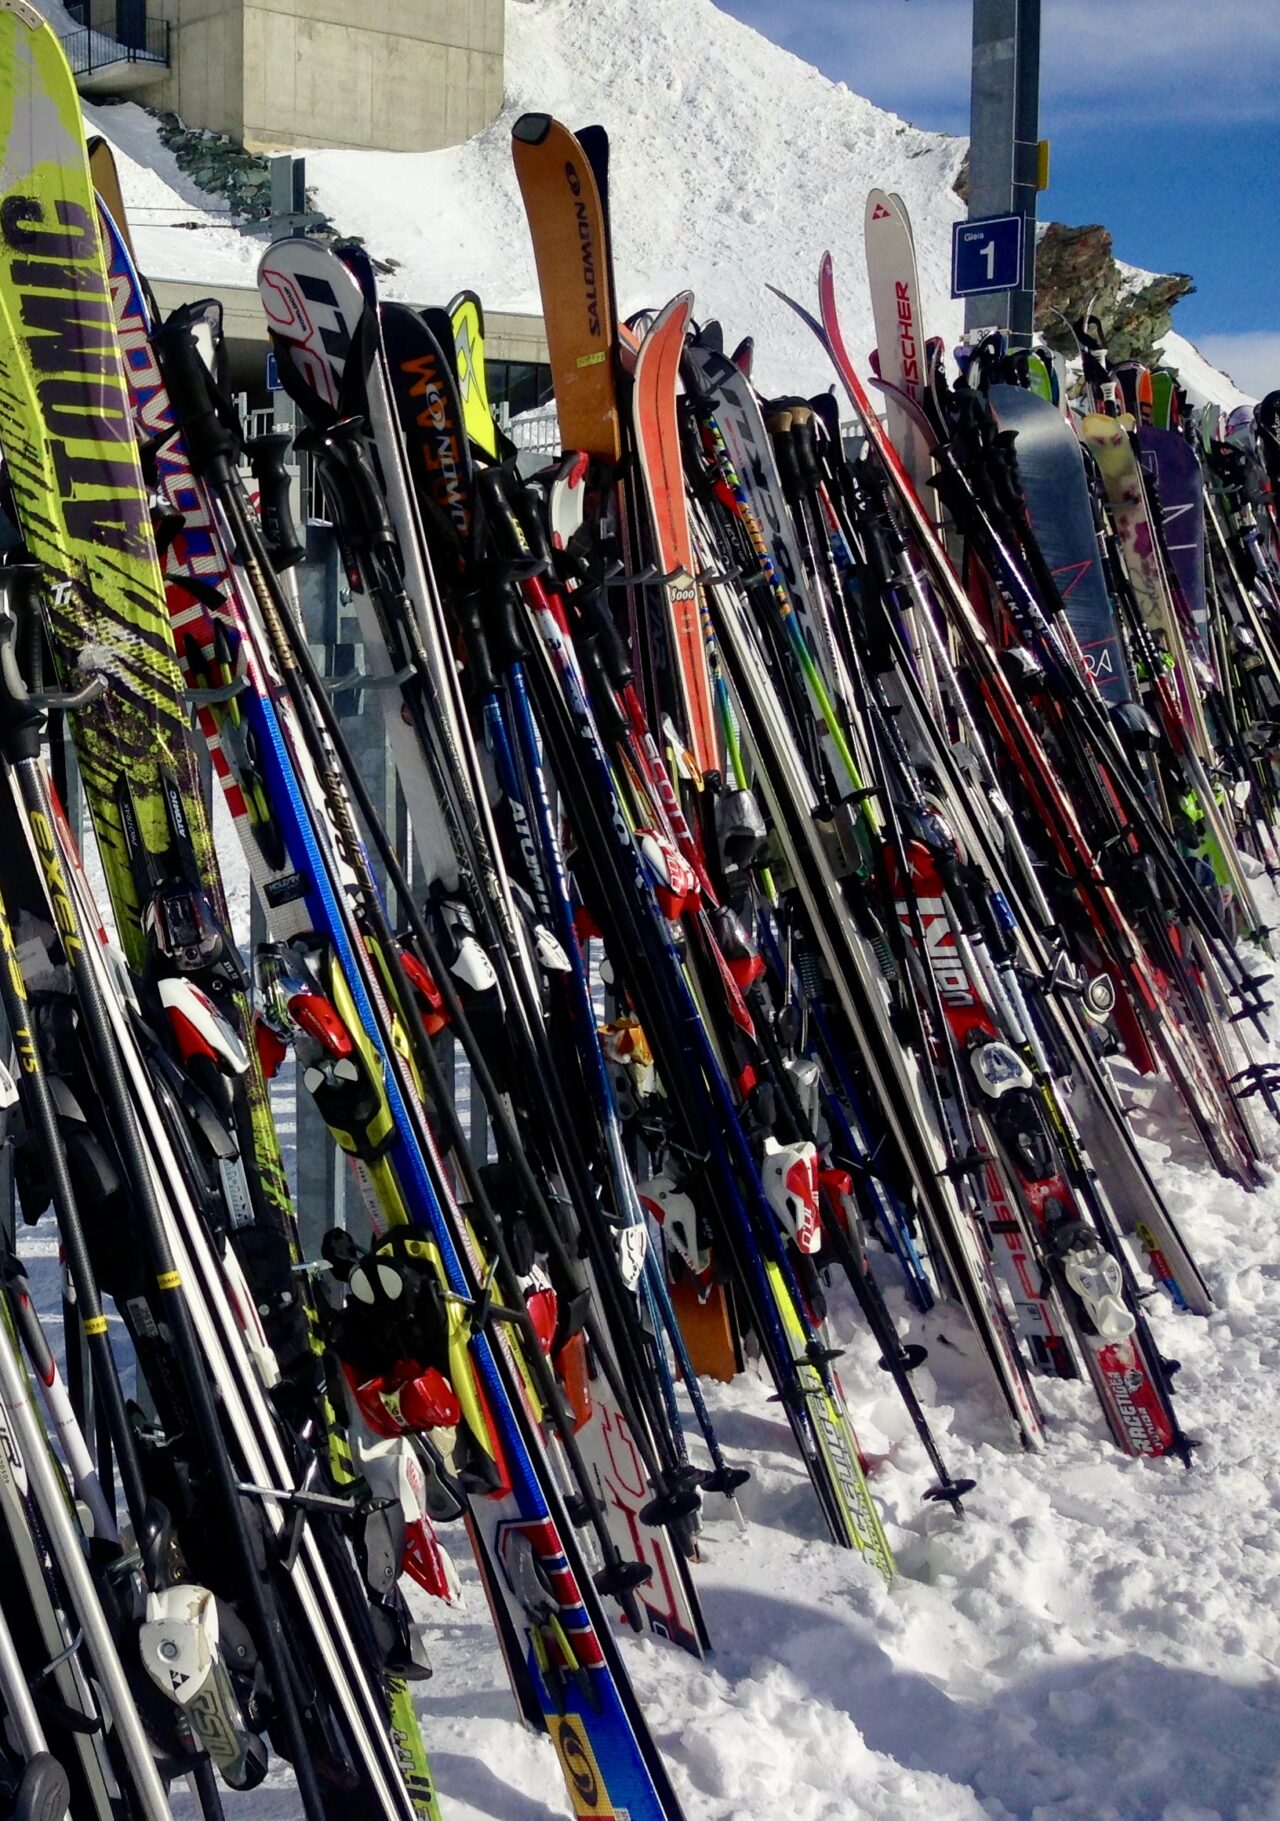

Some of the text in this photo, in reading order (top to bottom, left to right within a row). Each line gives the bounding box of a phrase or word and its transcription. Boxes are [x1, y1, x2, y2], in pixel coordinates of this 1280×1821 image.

[964, 232, 985, 242] Gleis
[980, 240, 995, 280] 1
[574, 202, 602, 338] SALOMON
[283, 286, 308, 333] WORLDCUP
[895, 280, 920, 399] FISCHER
[0, 195, 153, 561] ATOMIC
[50, 581, 73, 608] Ti
[247, 558, 297, 669] KOMPERDELL
[994, 577, 1023, 621] LEKI
[170, 789, 188, 839] ATOMIC
[31, 811, 78, 966] EXEL
[16, 1027, 42, 1073] 115
[1107, 1371, 1148, 1455] RACETIGER
